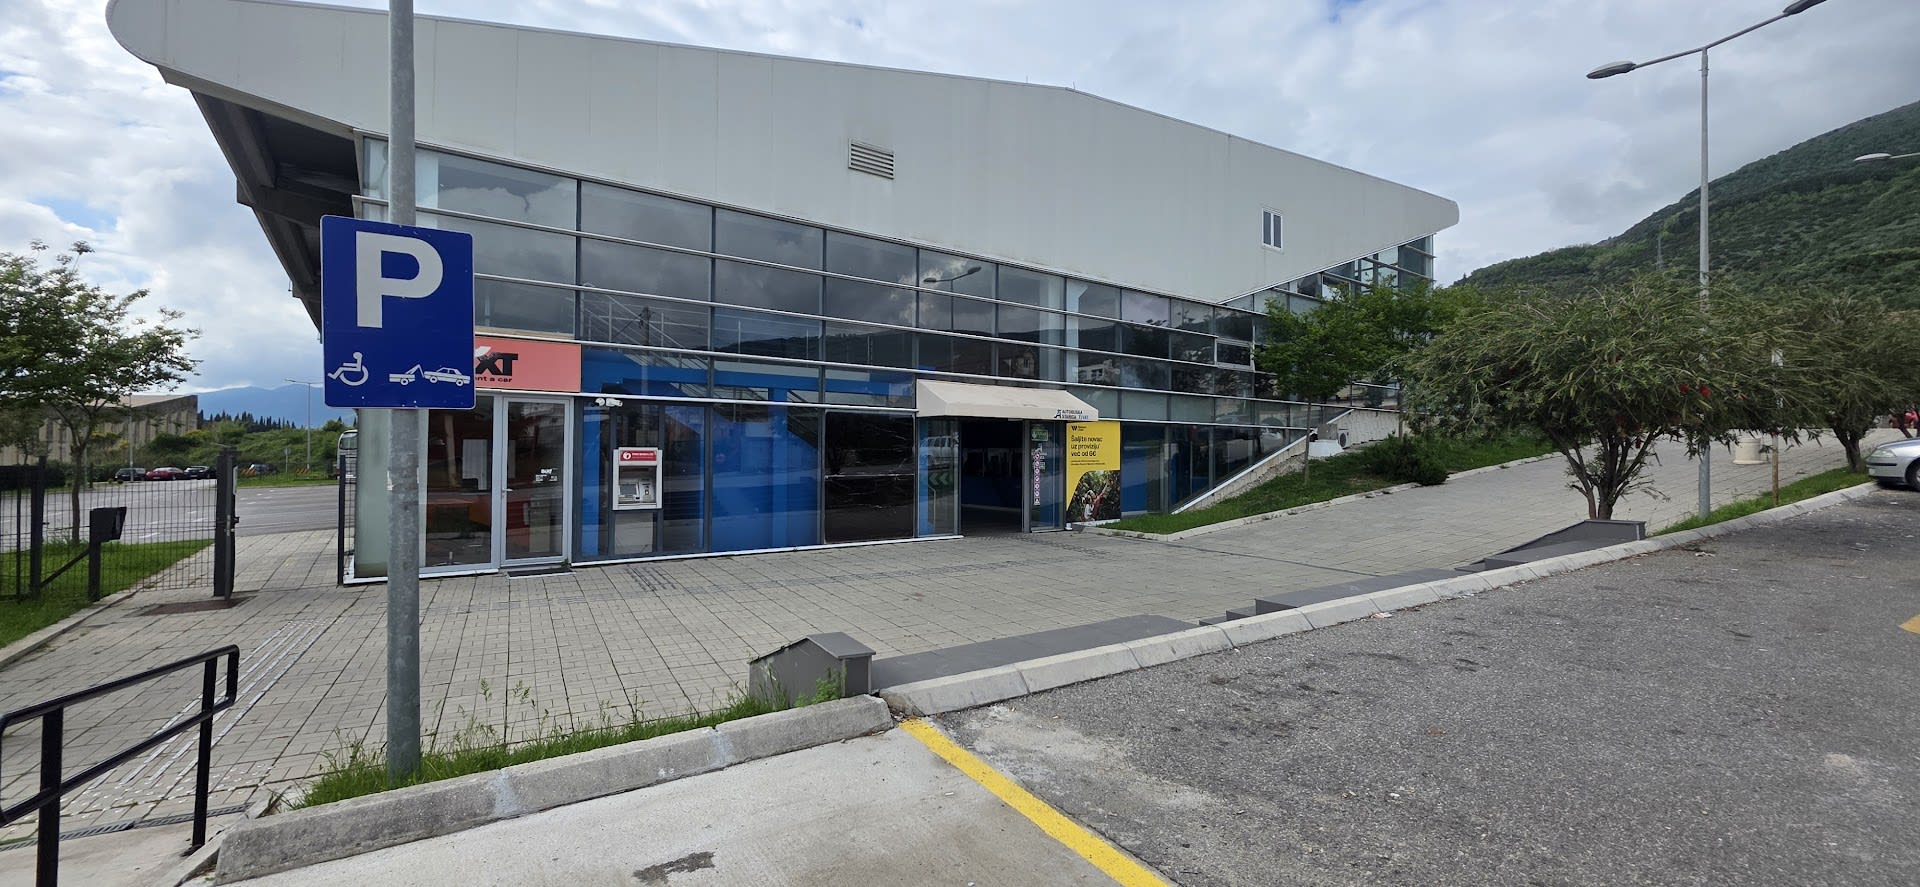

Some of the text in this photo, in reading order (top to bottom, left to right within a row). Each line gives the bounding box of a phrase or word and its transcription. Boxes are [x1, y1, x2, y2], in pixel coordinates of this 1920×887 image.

[356, 231, 443, 328] P
[475, 352, 518, 376] XT
[1071, 435, 1087, 443] Šaljite
